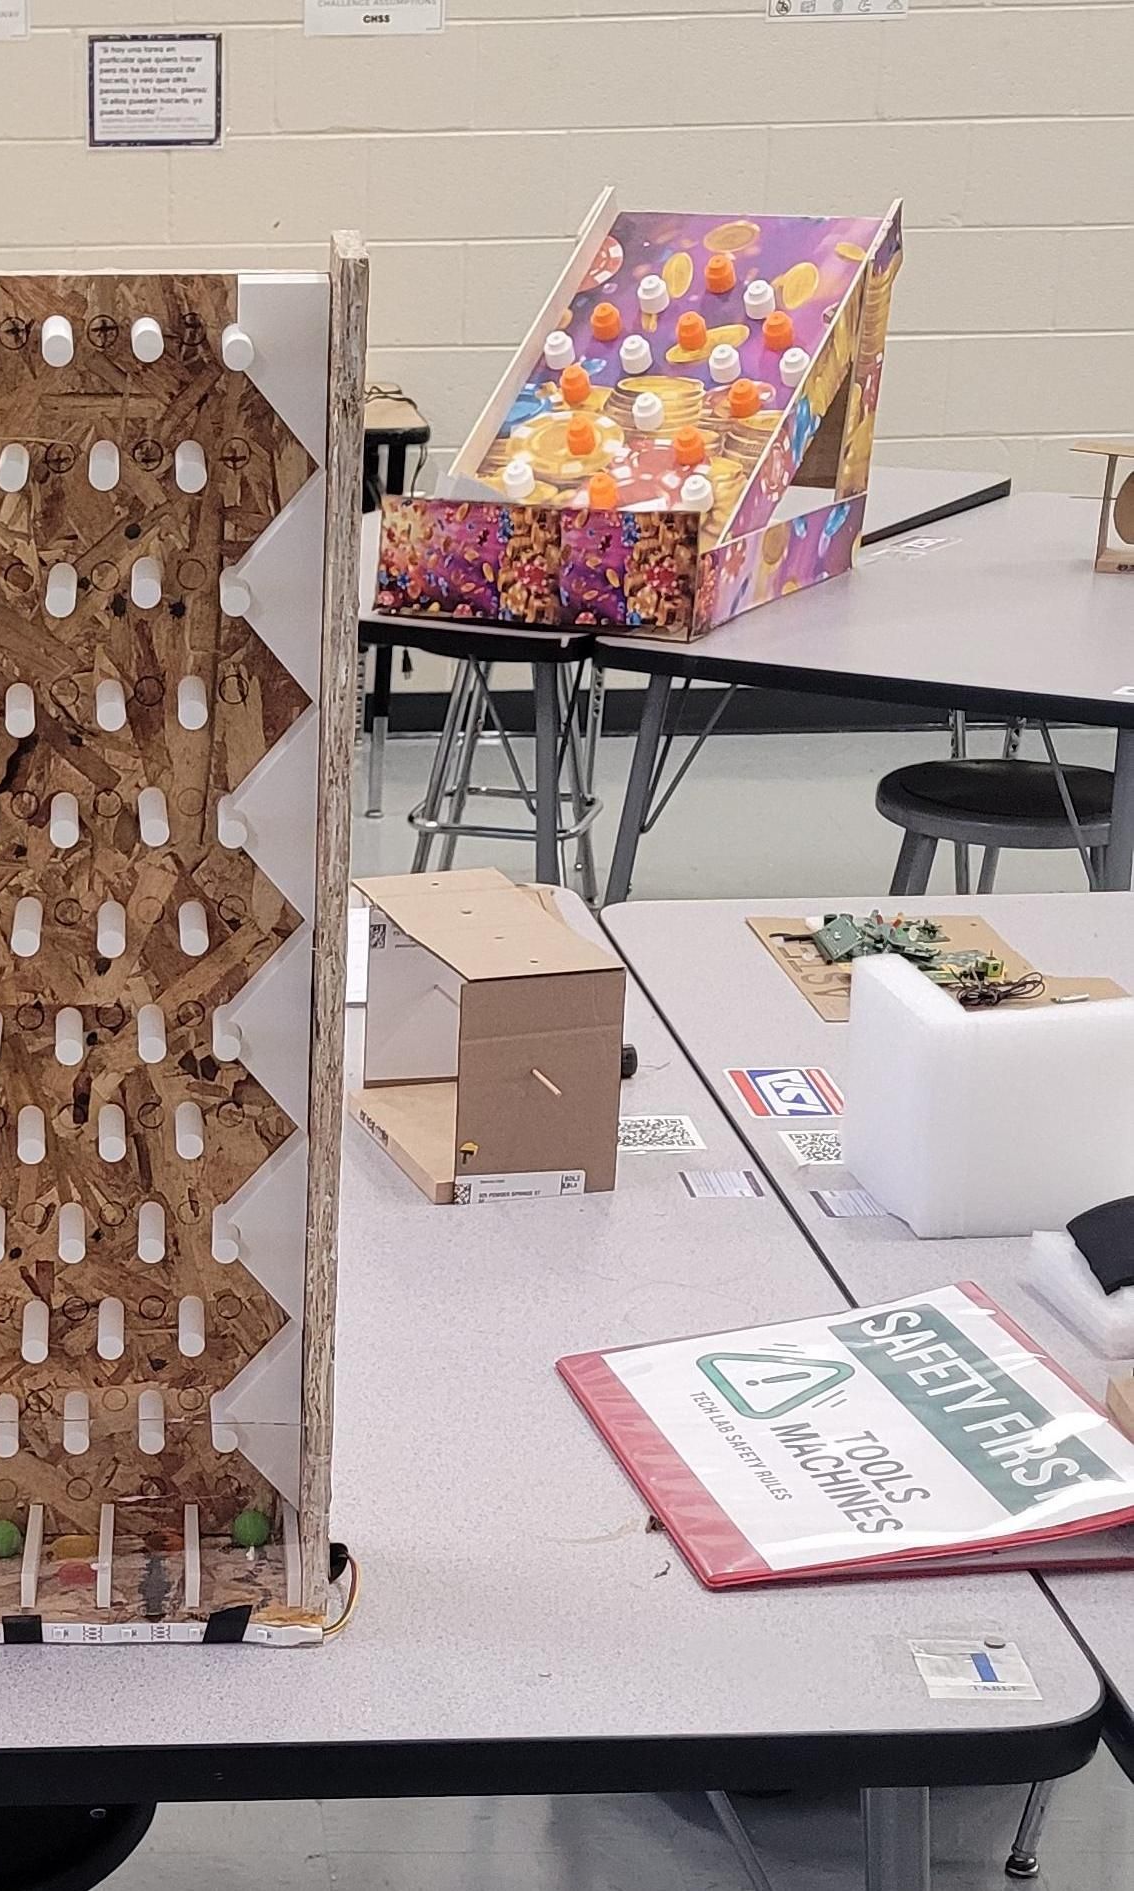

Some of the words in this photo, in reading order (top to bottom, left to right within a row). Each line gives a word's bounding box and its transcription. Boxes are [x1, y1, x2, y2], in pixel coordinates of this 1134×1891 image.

[860, 1311, 1010, 1413] SAFETY
[689, 1391, 713, 1415] TECH
[709, 1413, 735, 1434] LAB
[725, 1432, 767, 1468] SAFETY
[753, 1468, 794, 1501] RULES
[769, 1422, 904, 1534] MACHINES
[834, 1430, 931, 1503] TOOLS
